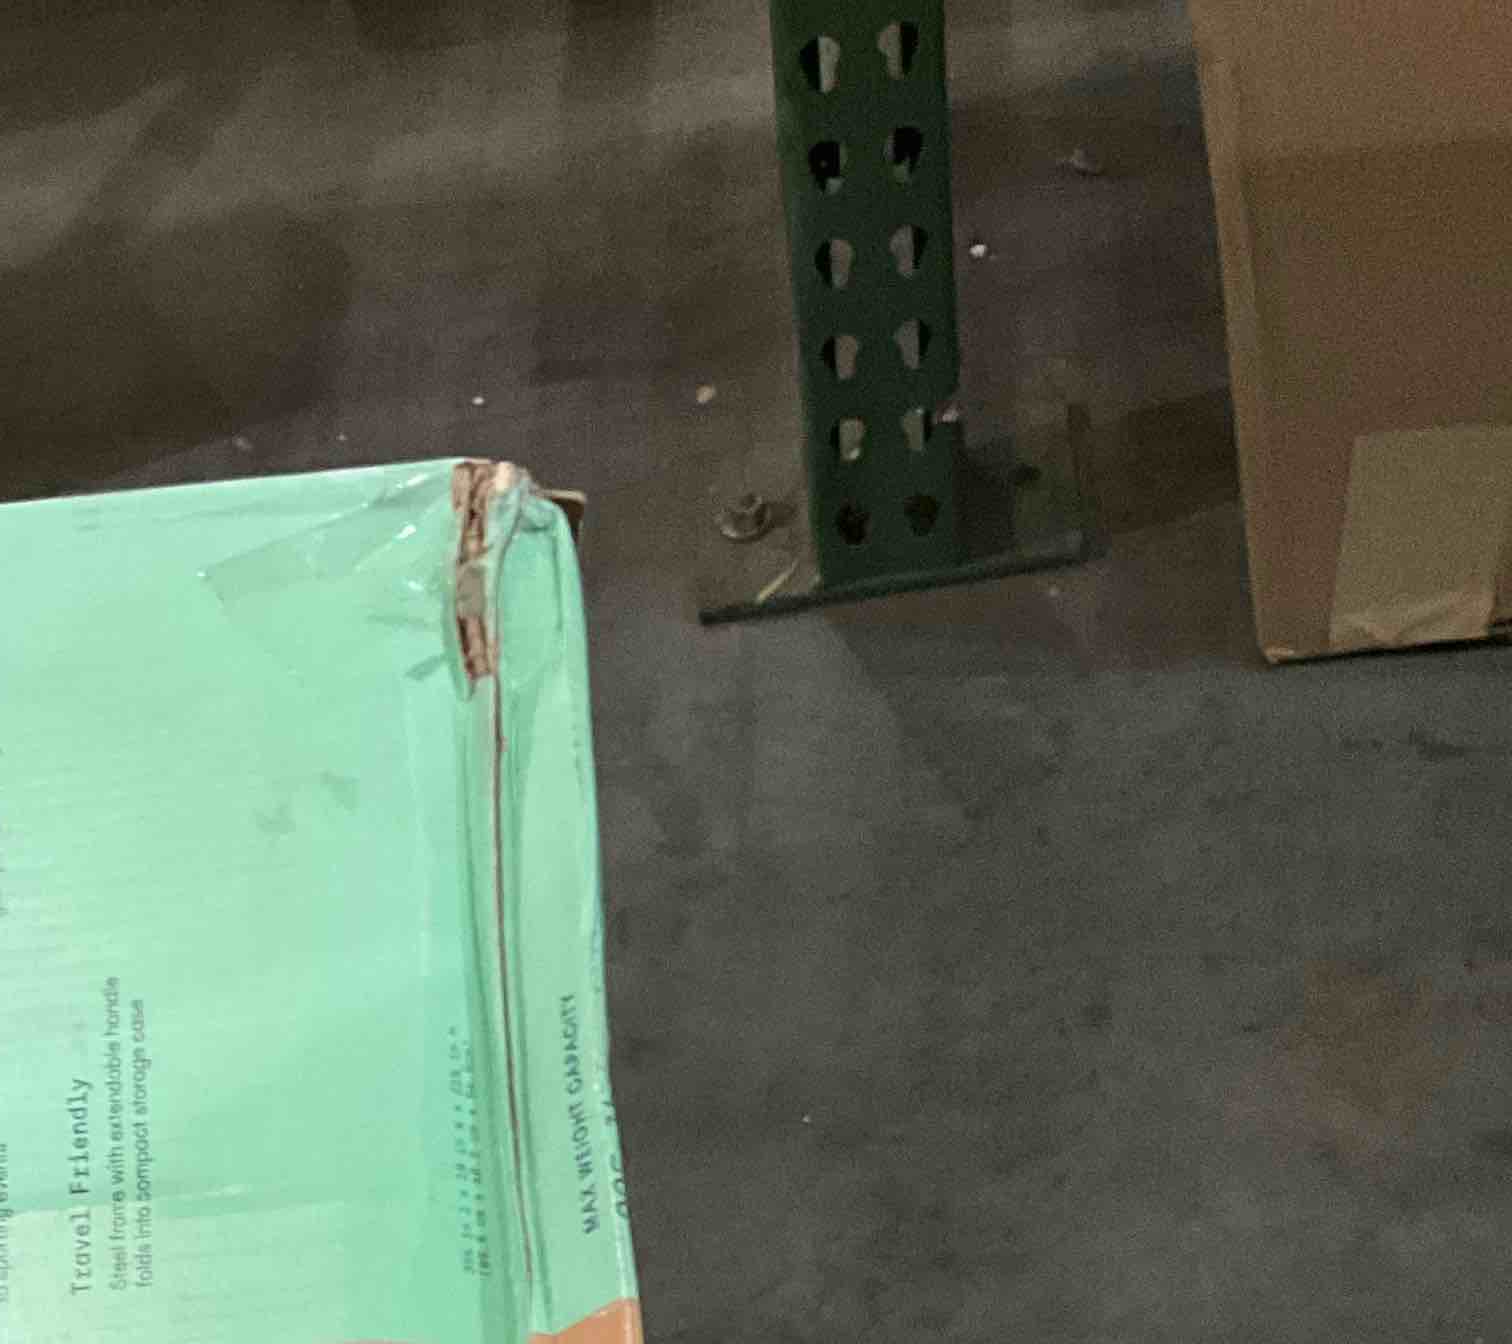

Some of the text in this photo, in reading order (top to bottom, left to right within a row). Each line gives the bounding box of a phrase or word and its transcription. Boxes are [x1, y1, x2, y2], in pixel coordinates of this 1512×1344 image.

[67, 1076, 93, 1295] Travel Friendly
[102, 976, 125, 1291] Steel frame with extendable handle
[127, 998, 153, 1288] folds into compact storage case
[559, 994, 601, 1235] MAX WEIGHT CAPACITY
